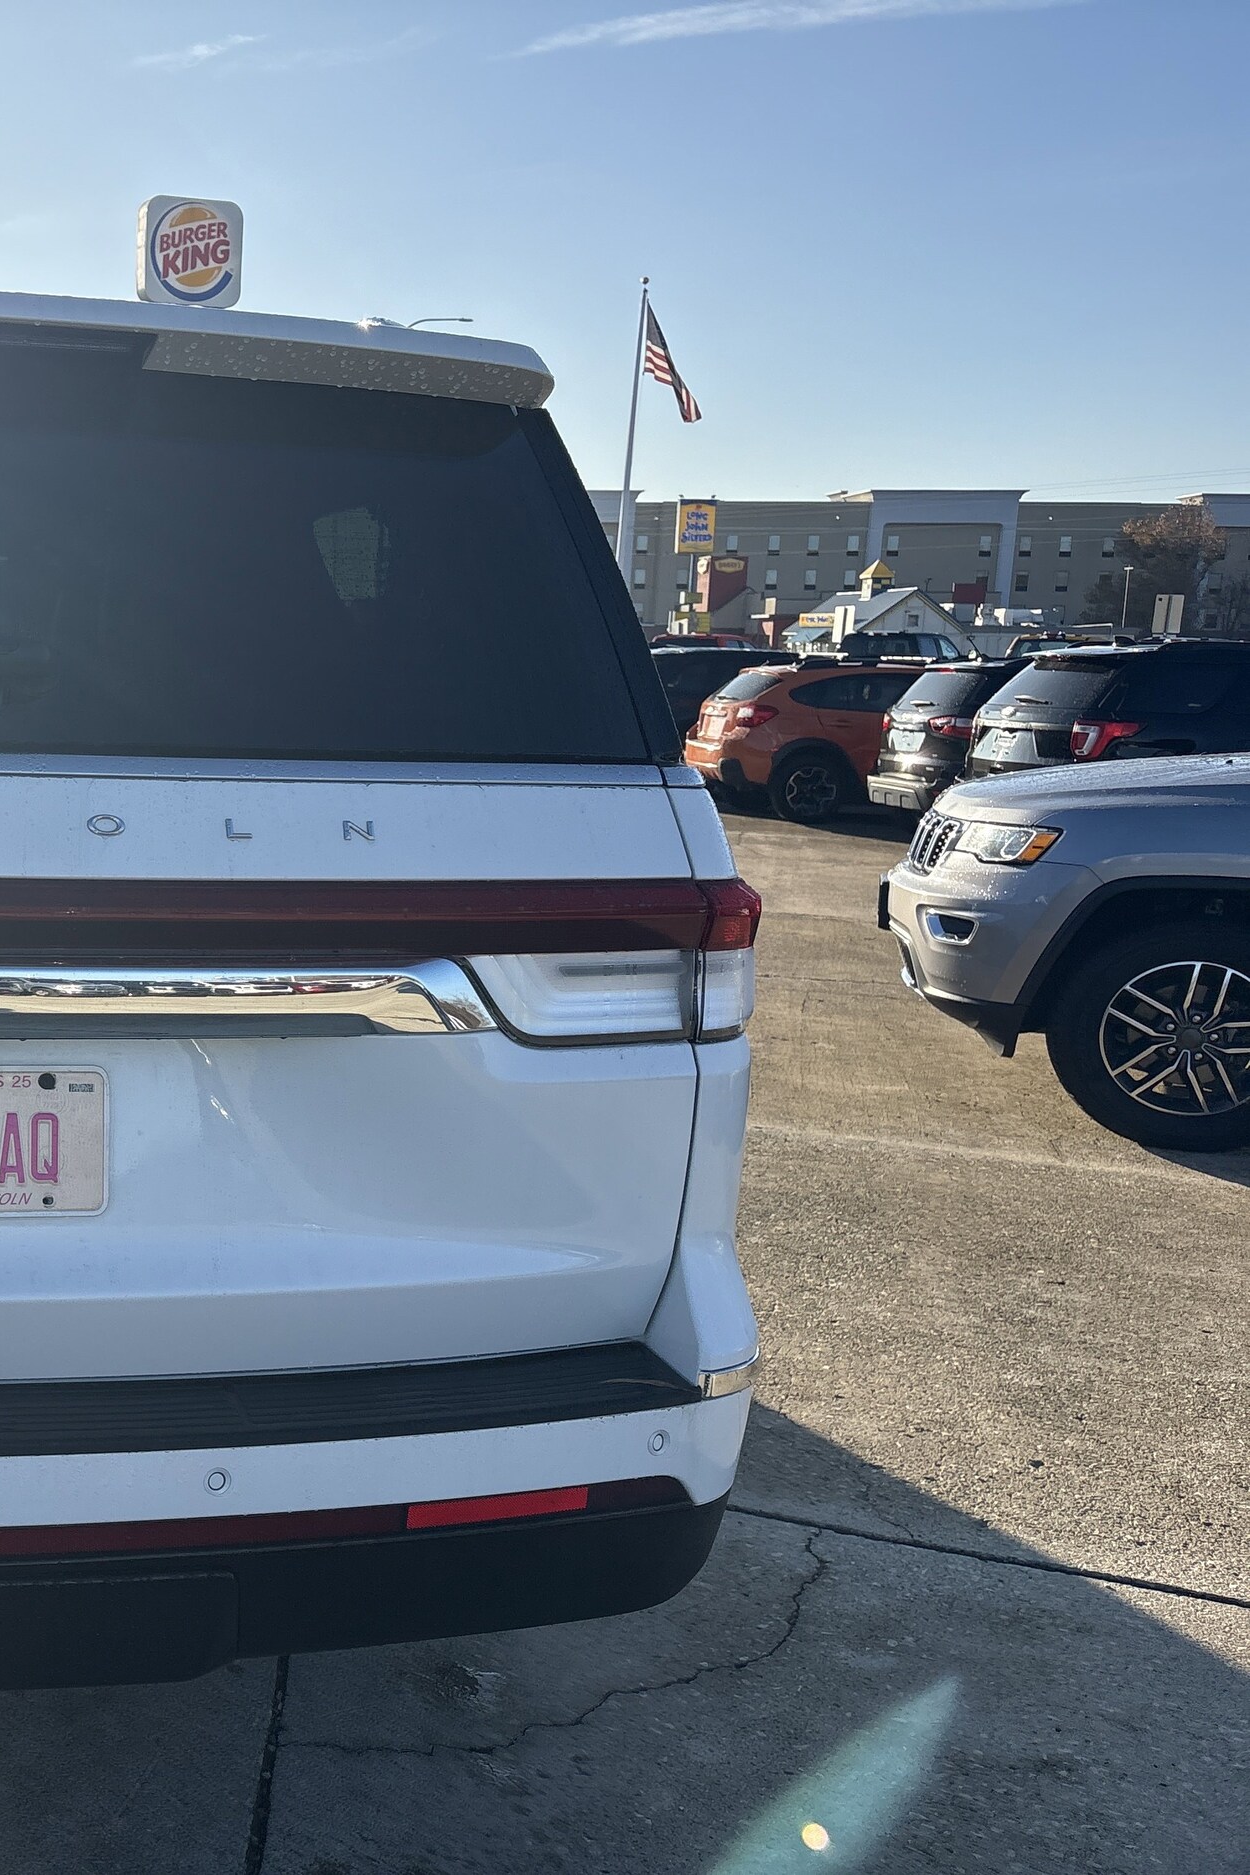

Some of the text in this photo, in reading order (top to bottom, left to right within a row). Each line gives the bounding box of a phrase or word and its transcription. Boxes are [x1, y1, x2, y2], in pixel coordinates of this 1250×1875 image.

[159, 222, 228, 253] BURGER
[162, 239, 230, 279] KING
[11, 1075, 32, 1088] 25
